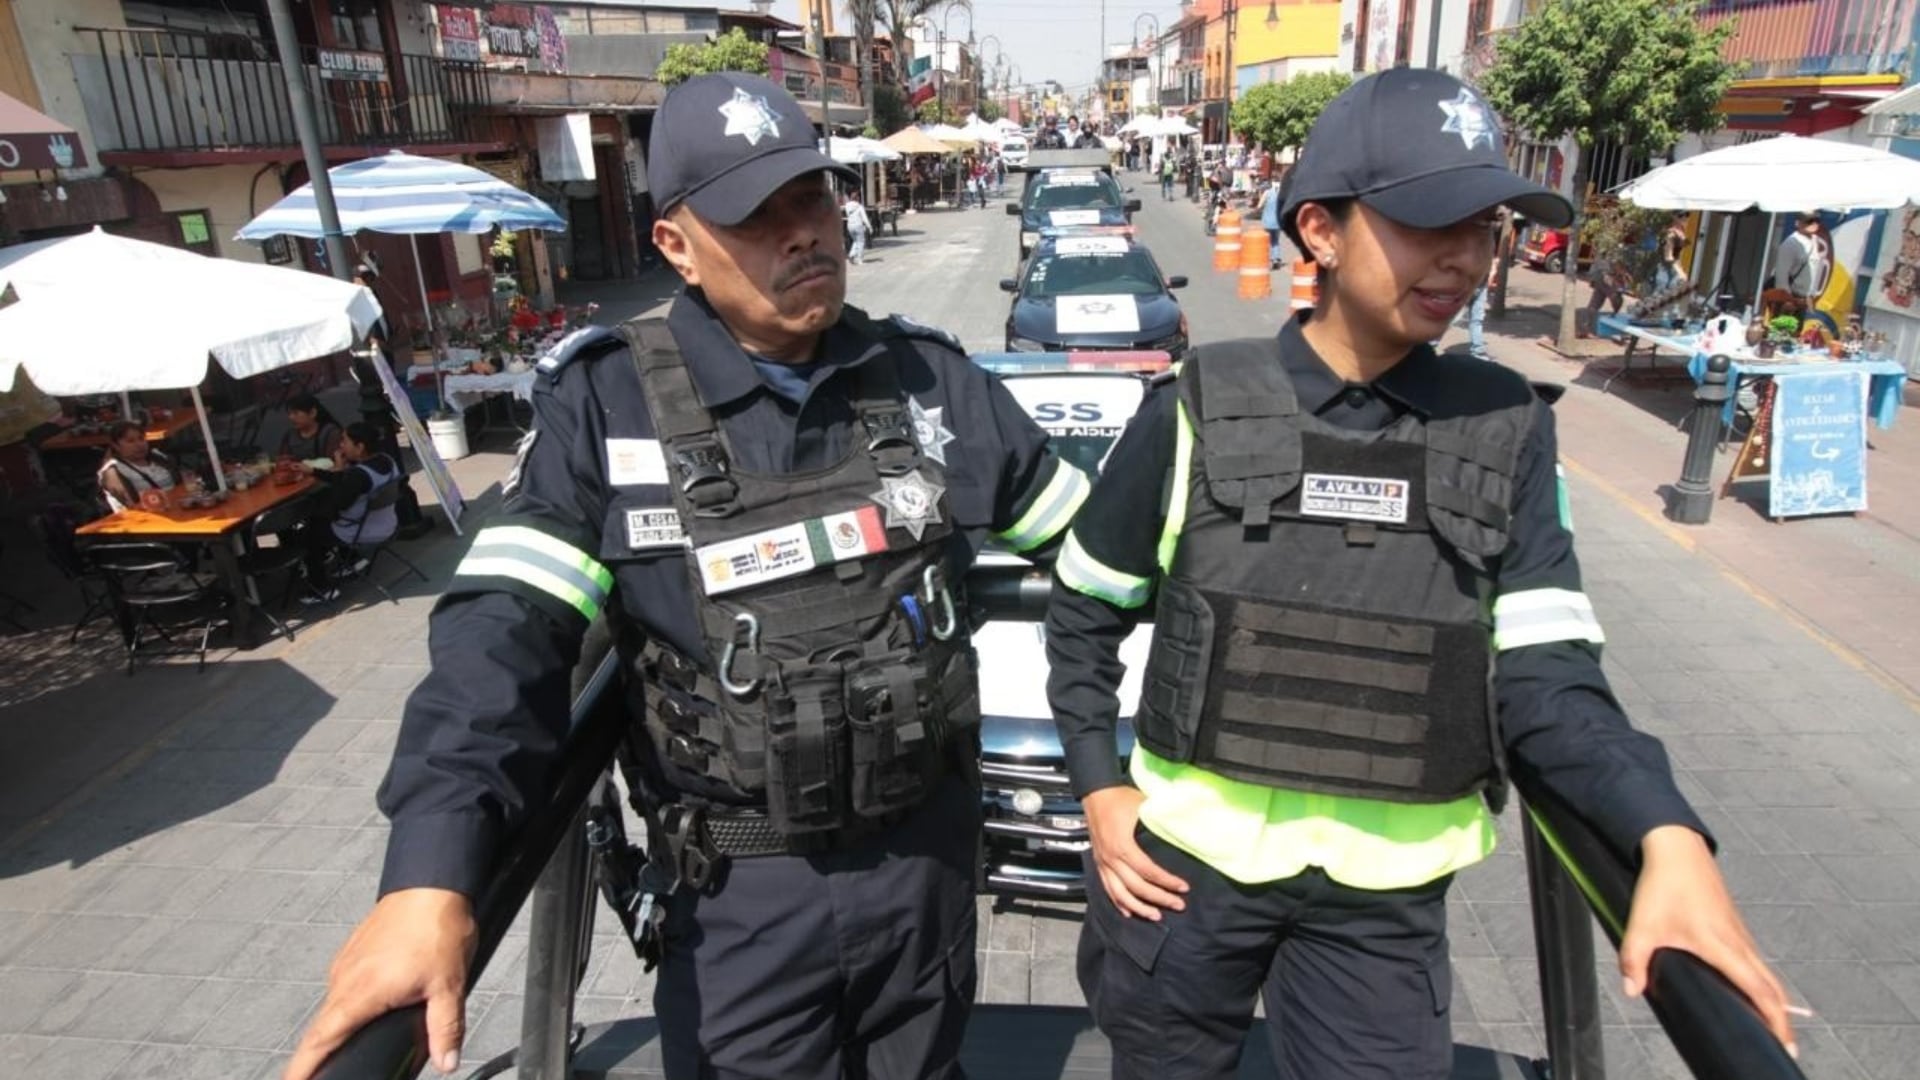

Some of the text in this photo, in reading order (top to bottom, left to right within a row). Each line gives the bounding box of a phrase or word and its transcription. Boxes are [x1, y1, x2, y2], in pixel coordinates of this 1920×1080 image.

[320, 51, 385, 73] CLUB ZERO
[1033, 402, 1103, 422] SS
[1325, 479, 1366, 495] AVILA
[1382, 500, 1403, 518] SS
